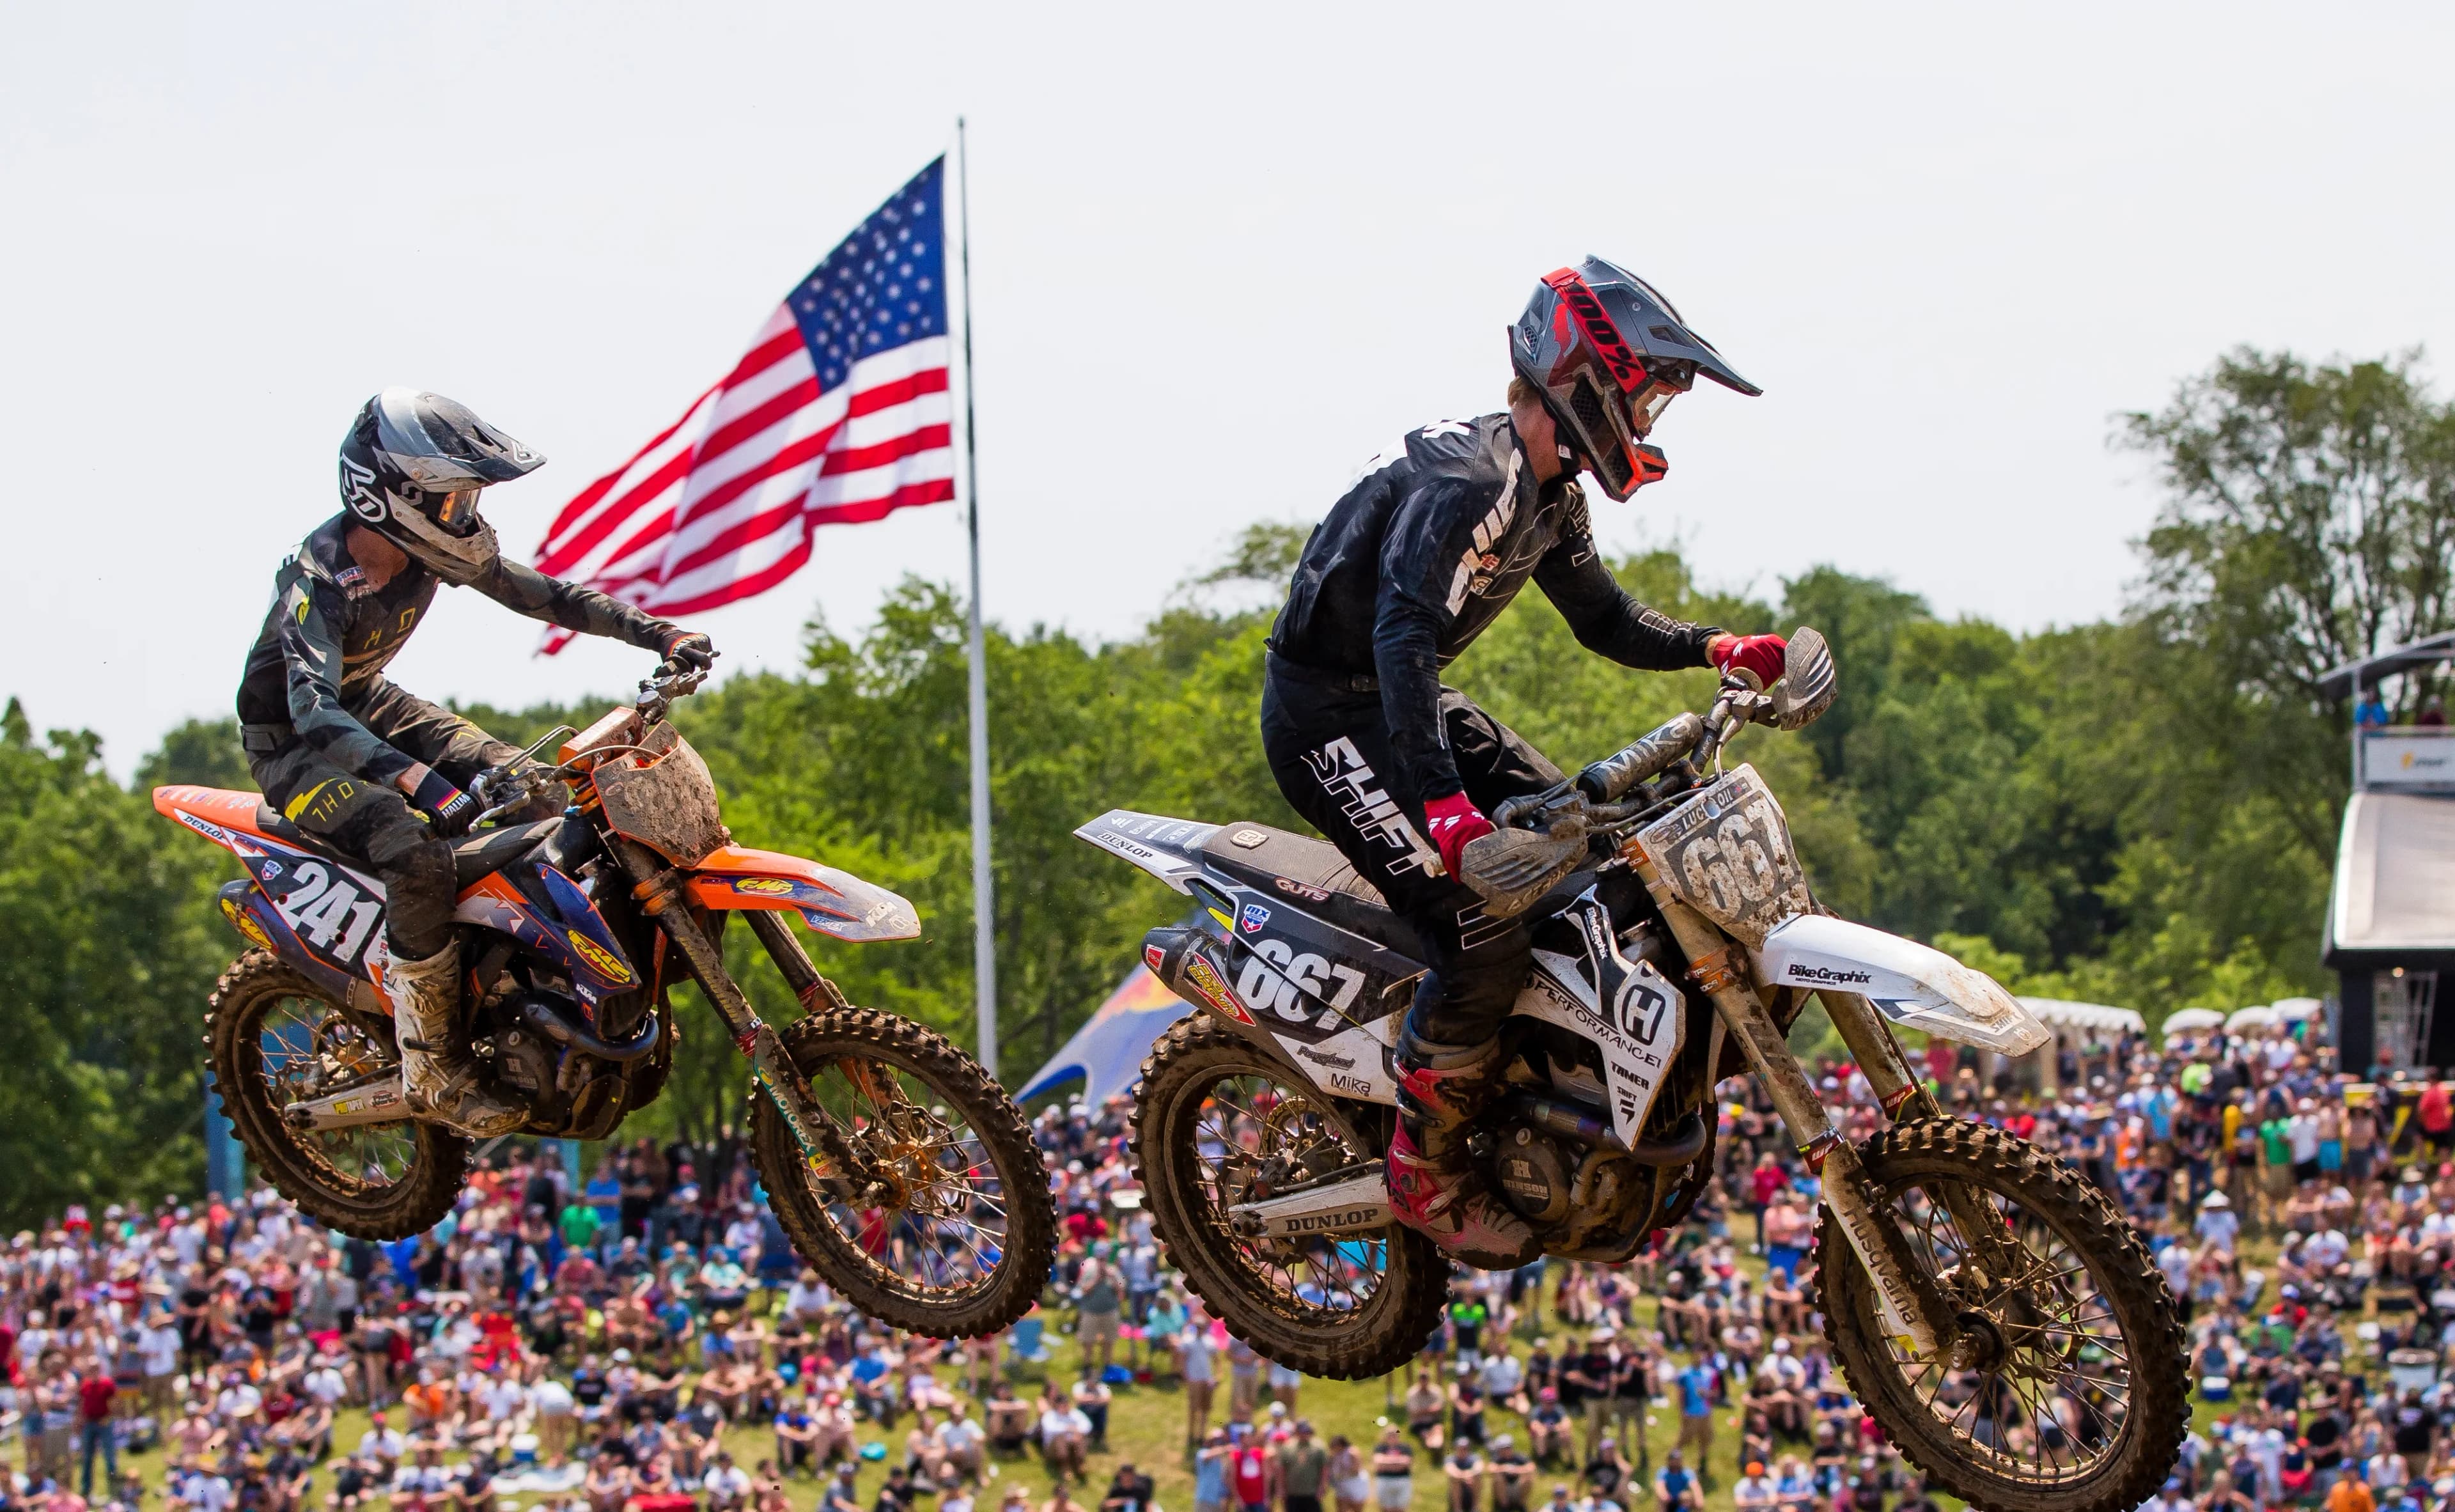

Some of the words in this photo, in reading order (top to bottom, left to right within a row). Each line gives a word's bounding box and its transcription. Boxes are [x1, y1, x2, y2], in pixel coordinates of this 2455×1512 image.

[1561, 281, 1641, 380] 100%
[1300, 736, 1436, 875] SHIFT
[1717, 788, 1733, 807] OIL
[1099, 832, 1153, 859] DUNLOP
[1682, 795, 1795, 919] 667
[1275, 879, 1330, 901] GUTS
[273, 862, 382, 963] 241
[1236, 939, 1366, 1031] 667
[1788, 964, 1872, 984] BikeGraphix
[576, 983, 597, 1004] KTM
[1297, 1045, 1355, 1071] Powerband
[1331, 1073, 1371, 1096] Mika
[1617, 1086, 1637, 1101] SHIFT
[1285, 1208, 1378, 1232] DUNLOP
[1843, 1208, 1917, 1325] Husqvarna
